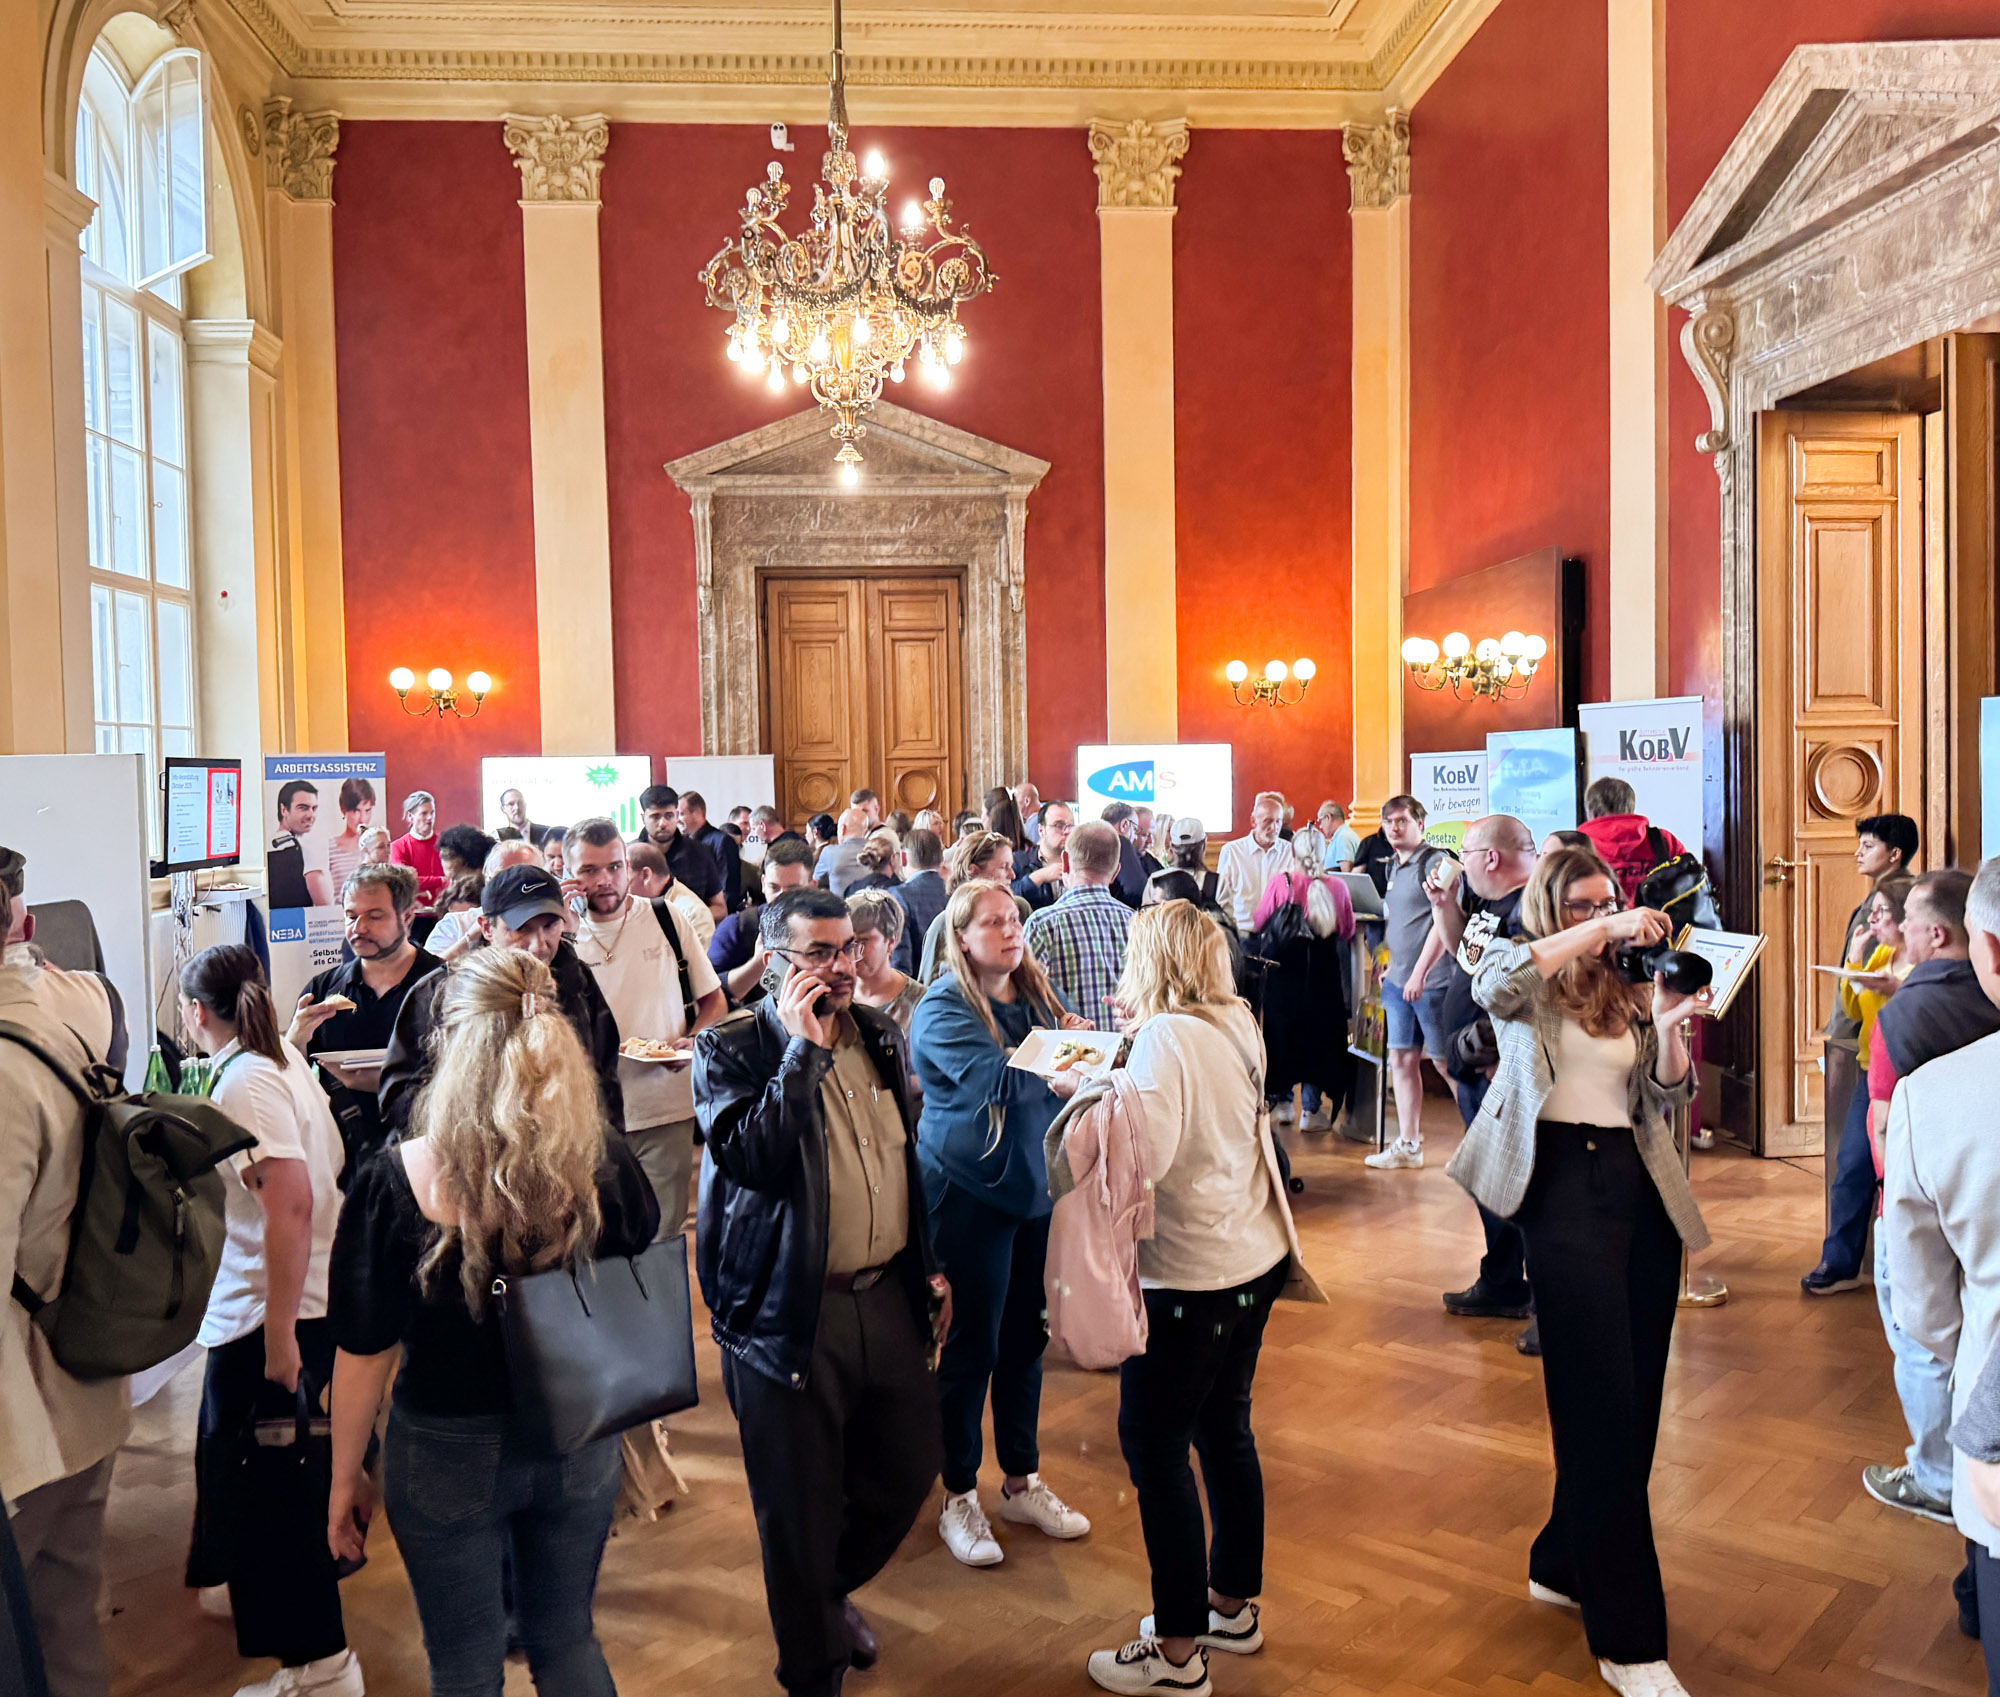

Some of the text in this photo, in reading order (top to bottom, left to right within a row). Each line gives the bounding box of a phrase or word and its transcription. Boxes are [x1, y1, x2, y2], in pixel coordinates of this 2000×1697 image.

[275, 763, 376, 774] ARBEITSASSISTENZ
[1108, 770, 1176, 791] AMS
[1433, 797, 1481, 814] Wir bewegen
[1426, 832, 1457, 844] Gesetze
[271, 928, 303, 940] NEBA
